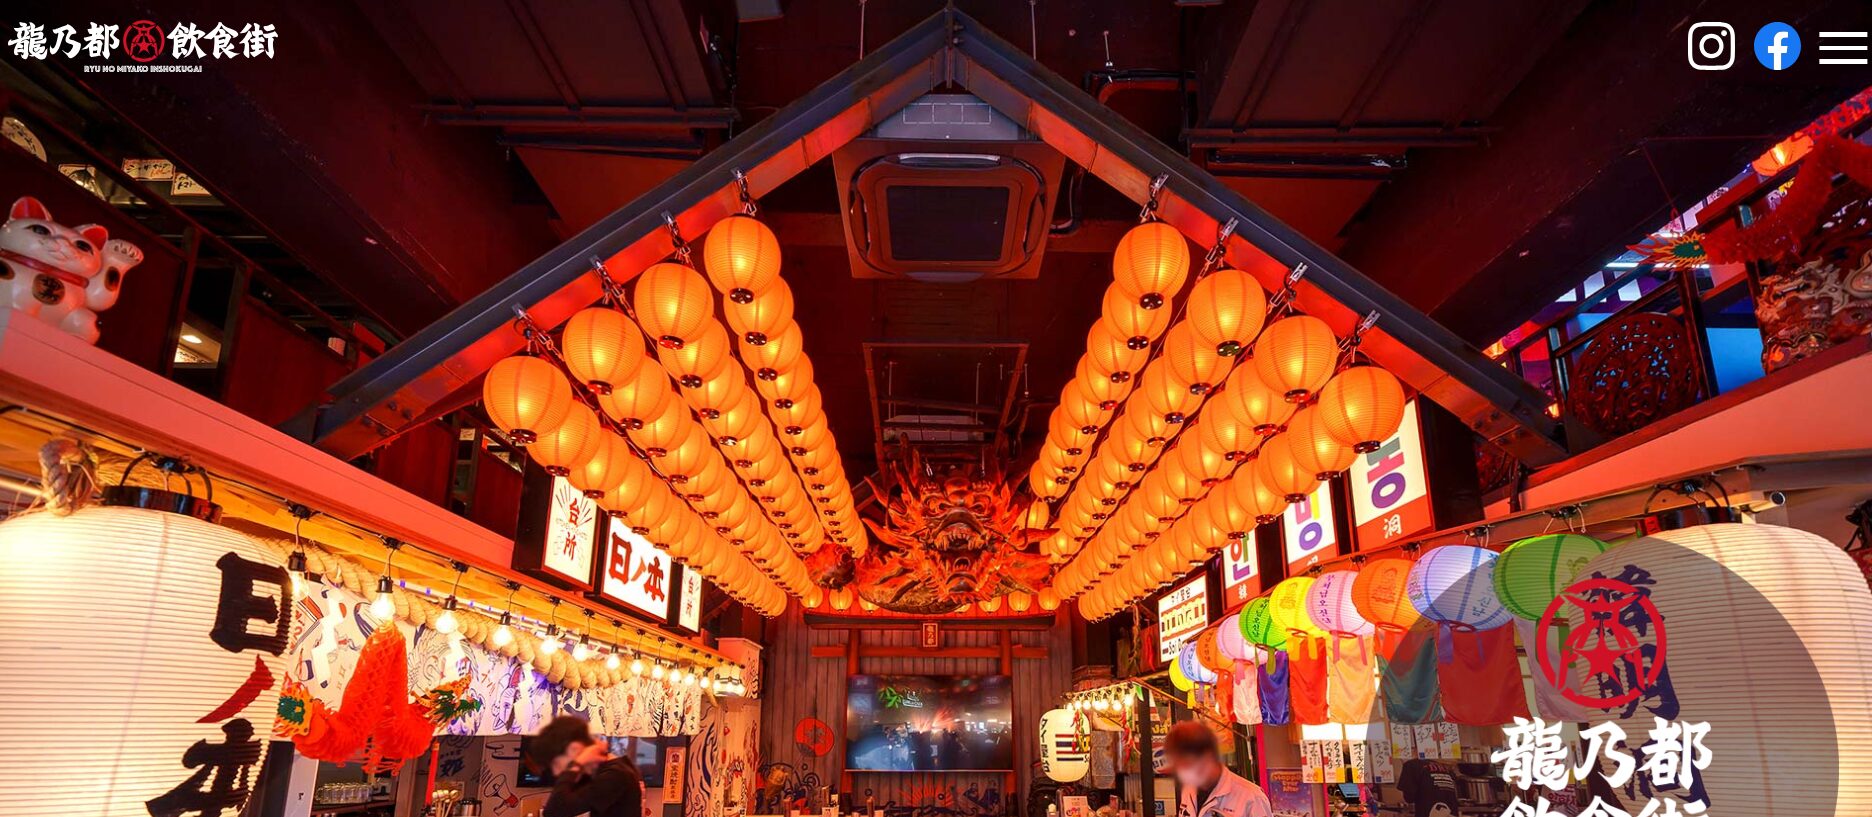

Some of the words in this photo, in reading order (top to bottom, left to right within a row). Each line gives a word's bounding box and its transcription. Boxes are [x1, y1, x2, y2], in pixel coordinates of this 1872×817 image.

[563, 498, 581, 561] 台所
[1382, 513, 1402, 539] 洞
[608, 531, 665, 602] 日ノ本
